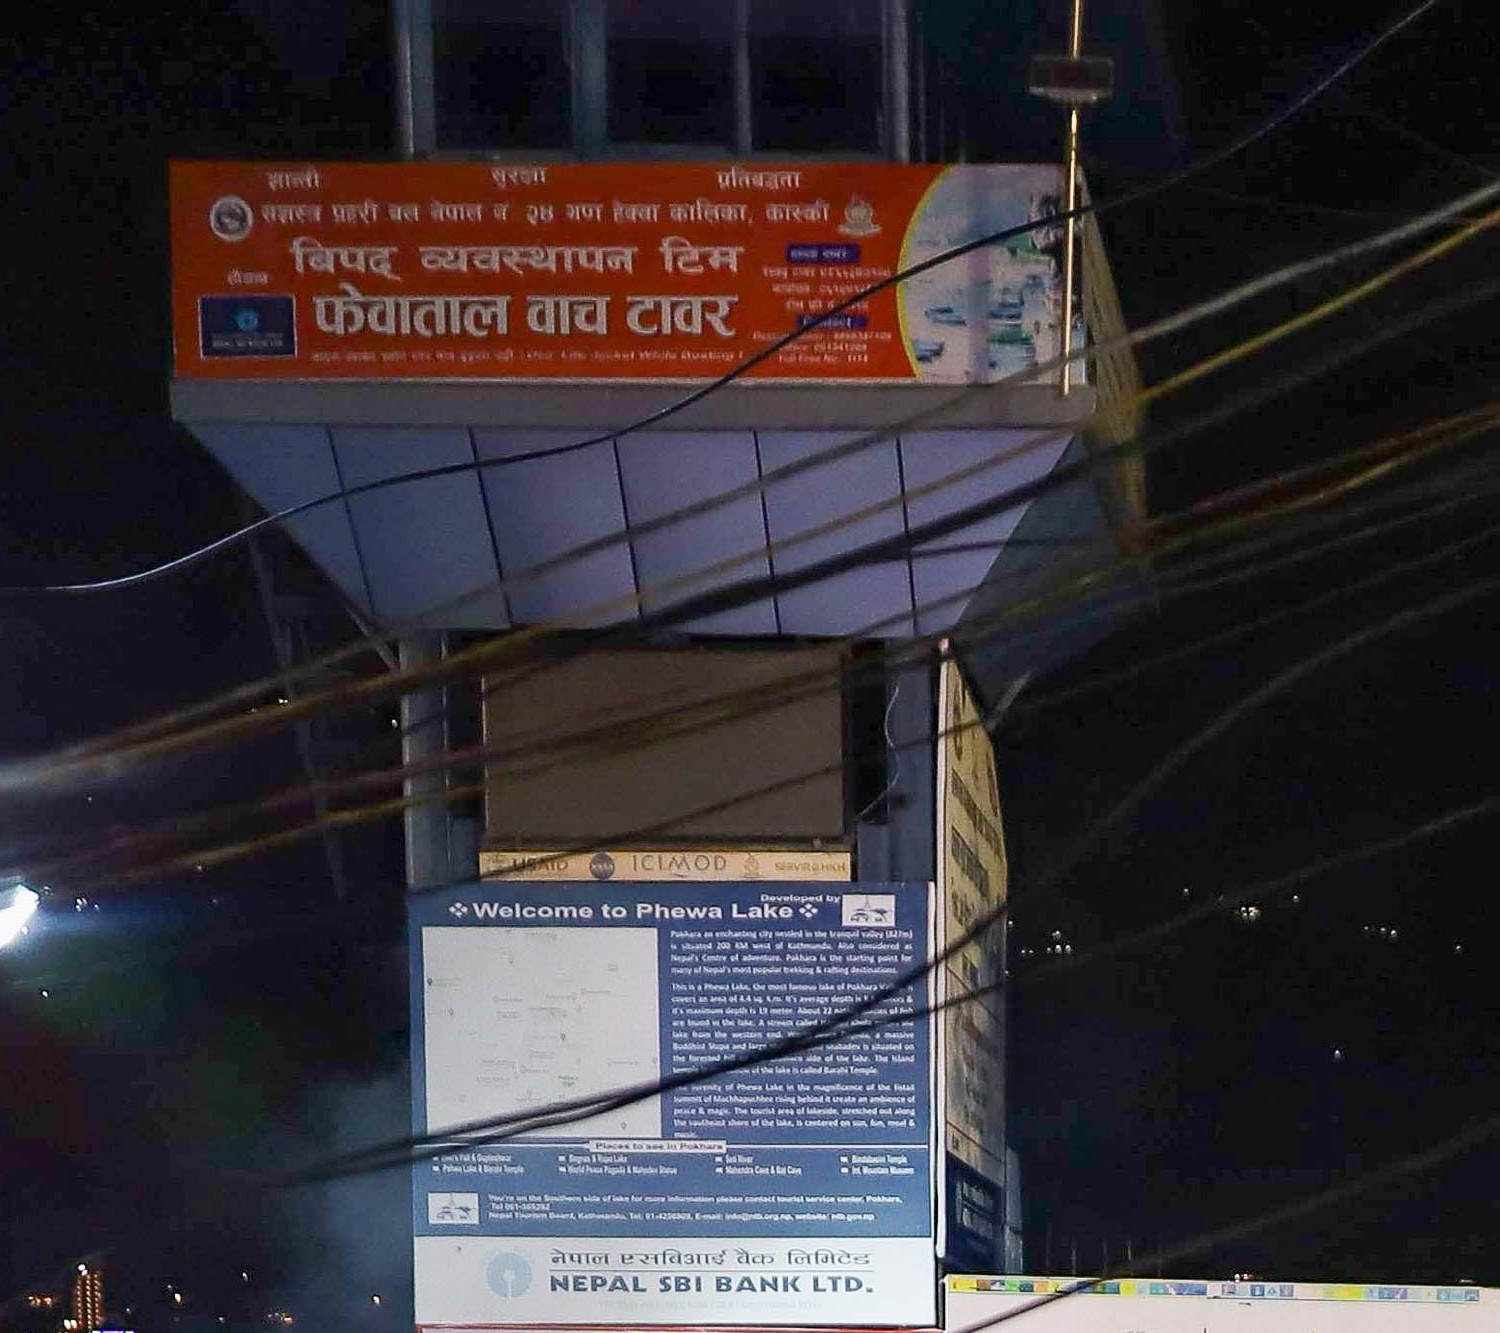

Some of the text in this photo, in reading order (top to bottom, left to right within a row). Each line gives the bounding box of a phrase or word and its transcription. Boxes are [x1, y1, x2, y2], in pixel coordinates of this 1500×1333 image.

[659, 235, 744, 275] टिम
[311, 282, 738, 337] फेवाताल वाच टावर
[633, 855, 726, 872] ICIMOD
[760, 894, 841, 904] Developed by
[474, 902, 793, 919] Welcome to Phewa Lake
[595, 1142, 630, 1150] Places
[632, 1142, 643, 1150] to
[680, 1142, 723, 1150] Pokhara
[550, 1248, 610, 1266] नेपाल
[787, 1247, 871, 1266] लिमिटेड
[550, 1275, 874, 1293] NEPAL SBI BANK LTD.
